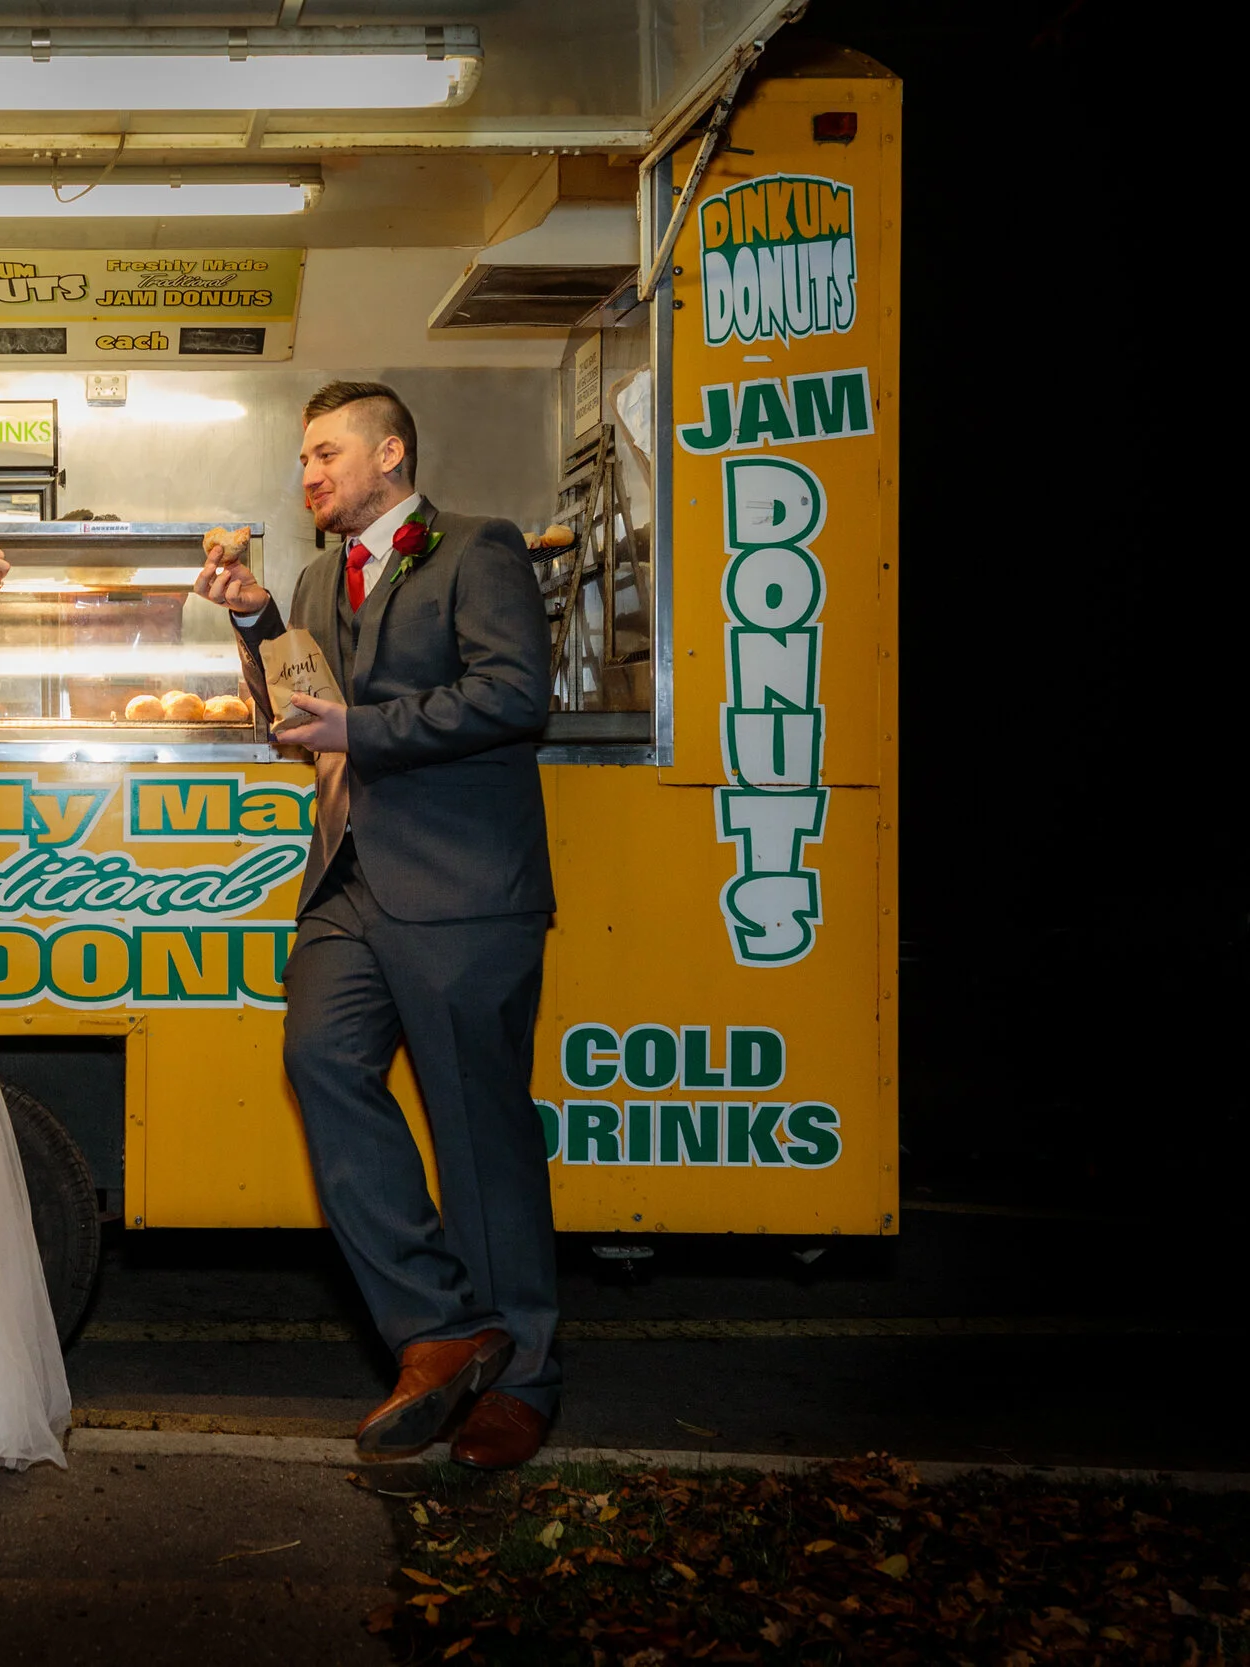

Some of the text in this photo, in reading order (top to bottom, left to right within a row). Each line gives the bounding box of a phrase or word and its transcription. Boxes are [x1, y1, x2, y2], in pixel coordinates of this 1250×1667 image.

[702, 180, 851, 251] DINKUM
[107, 260, 268, 273] Freshly Made
[138, 273, 237, 288] Traditional
[704, 236, 856, 346] DONUTS
[96, 290, 272, 306] JAM DONUTS
[95, 331, 169, 350] each
[679, 371, 871, 451] JAM
[274, 653, 319, 684] donut
[718, 457, 828, 963] DONUTS
[133, 780, 316, 834] Ma
[563, 1025, 784, 1089] COLD
